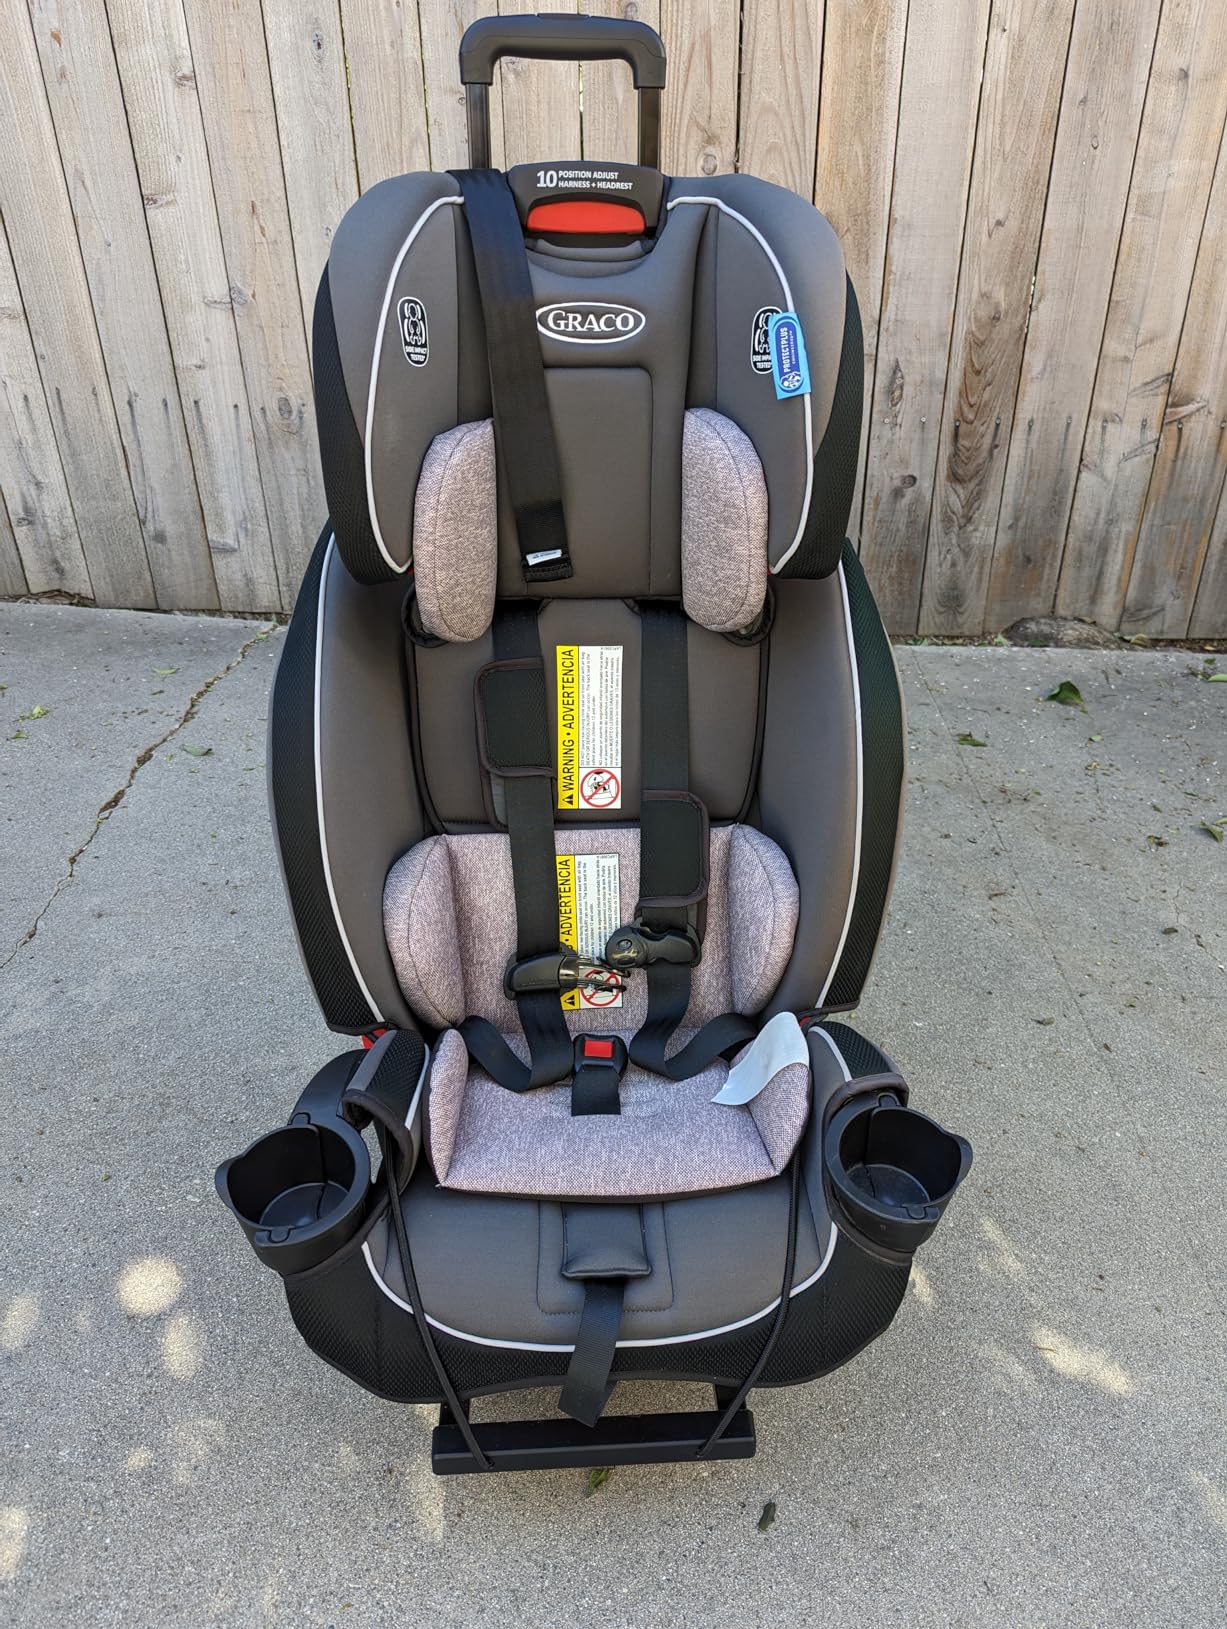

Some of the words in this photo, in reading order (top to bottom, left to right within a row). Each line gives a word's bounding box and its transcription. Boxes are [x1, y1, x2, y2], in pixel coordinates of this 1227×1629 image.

[536, 170, 558, 188] 10
[558, 170, 592, 179] POSITION
[592, 171, 620, 180] ADJUST
[558, 180, 590, 188] HARNESS
[596, 181, 634, 190] HEADREST
[547, 310, 635, 332] GRACO
[780, 327, 791, 373] PROTECTPLUS
[562, 650, 575, 730] ADVERTENCIA
[562, 738, 575, 792] WARNING
[559, 859, 573, 936] ADVERTENCIA
